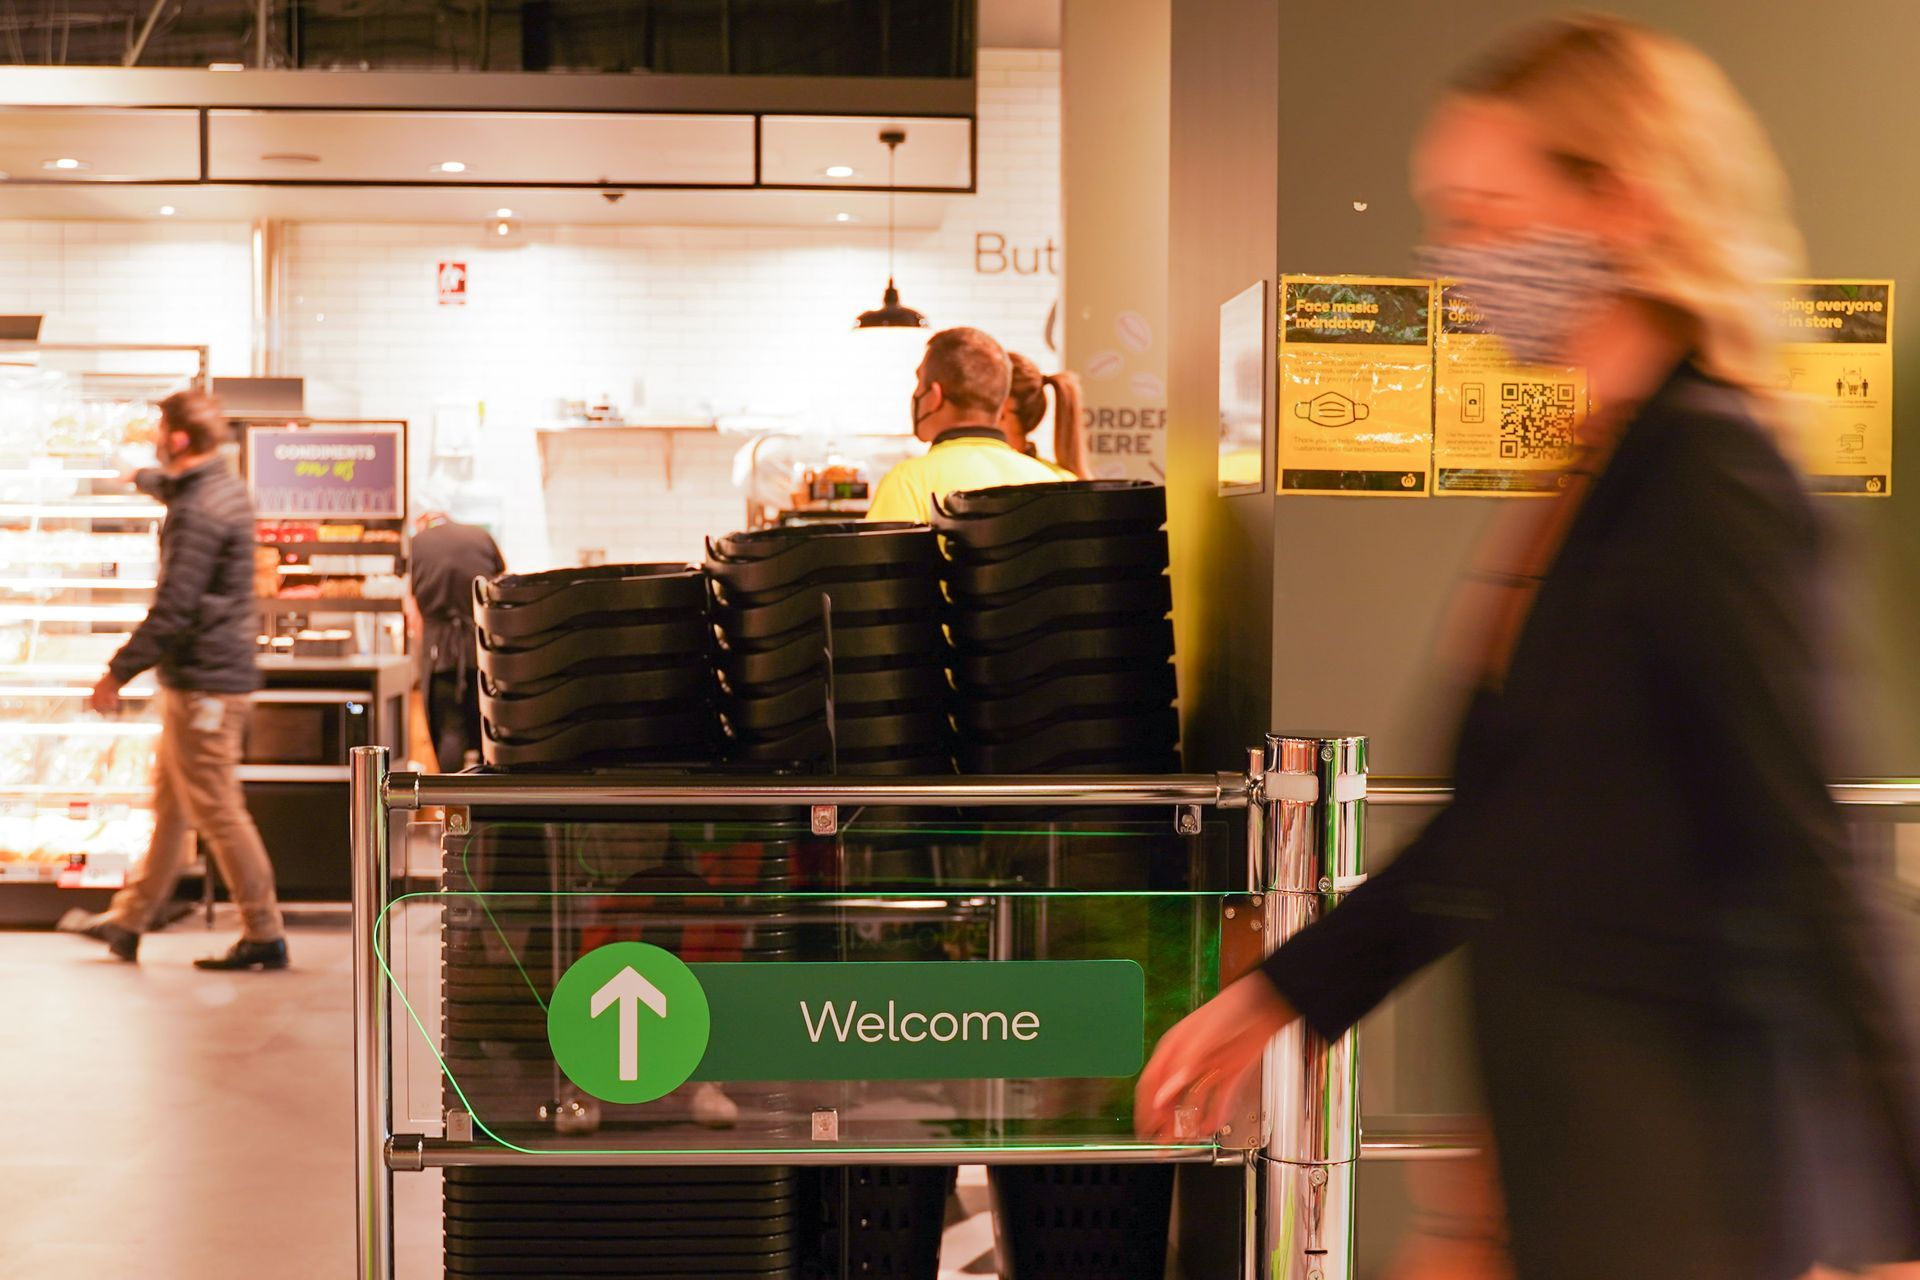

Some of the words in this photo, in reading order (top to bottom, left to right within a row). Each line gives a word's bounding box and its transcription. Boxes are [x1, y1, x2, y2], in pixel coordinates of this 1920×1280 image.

[975, 230, 1057, 275] But
[1296, 299, 1330, 312] Face
[1333, 301, 1379, 314] masks
[1815, 300, 1884, 315] everyone
[1295, 316, 1377, 333] mandatory
[1805, 315, 1843, 328] store
[800, 1000, 1041, 1043] Welcome
